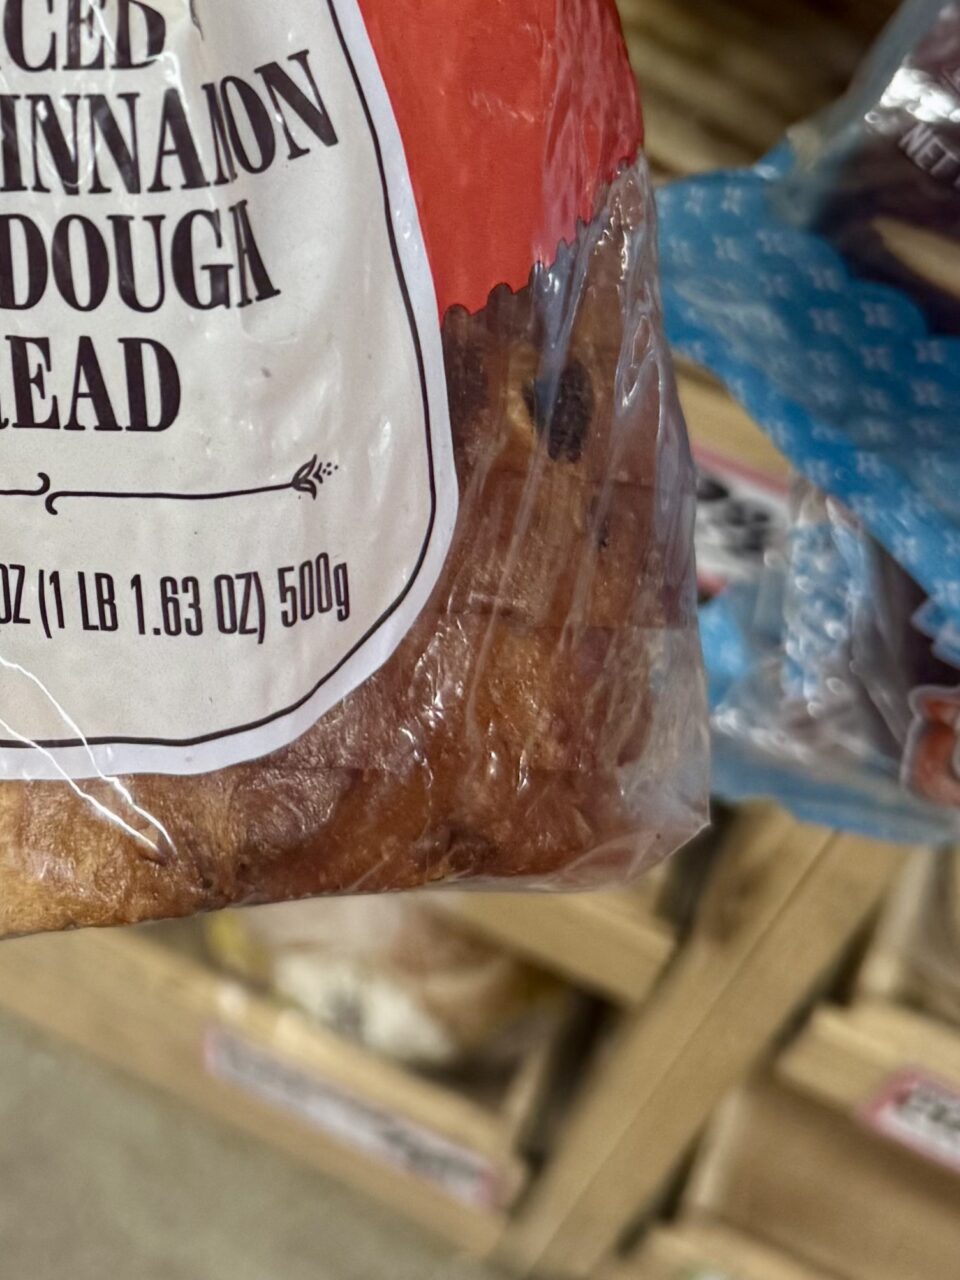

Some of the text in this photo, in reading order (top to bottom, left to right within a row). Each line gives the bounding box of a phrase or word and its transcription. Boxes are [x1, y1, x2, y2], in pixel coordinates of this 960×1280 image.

[38, 569, 67, 639] (1
[78, 571, 119, 632] LB
[130, 572, 203, 636] 1.63
[213, 570, 266, 644] OZ)
[276, 551, 352, 629] 500g
